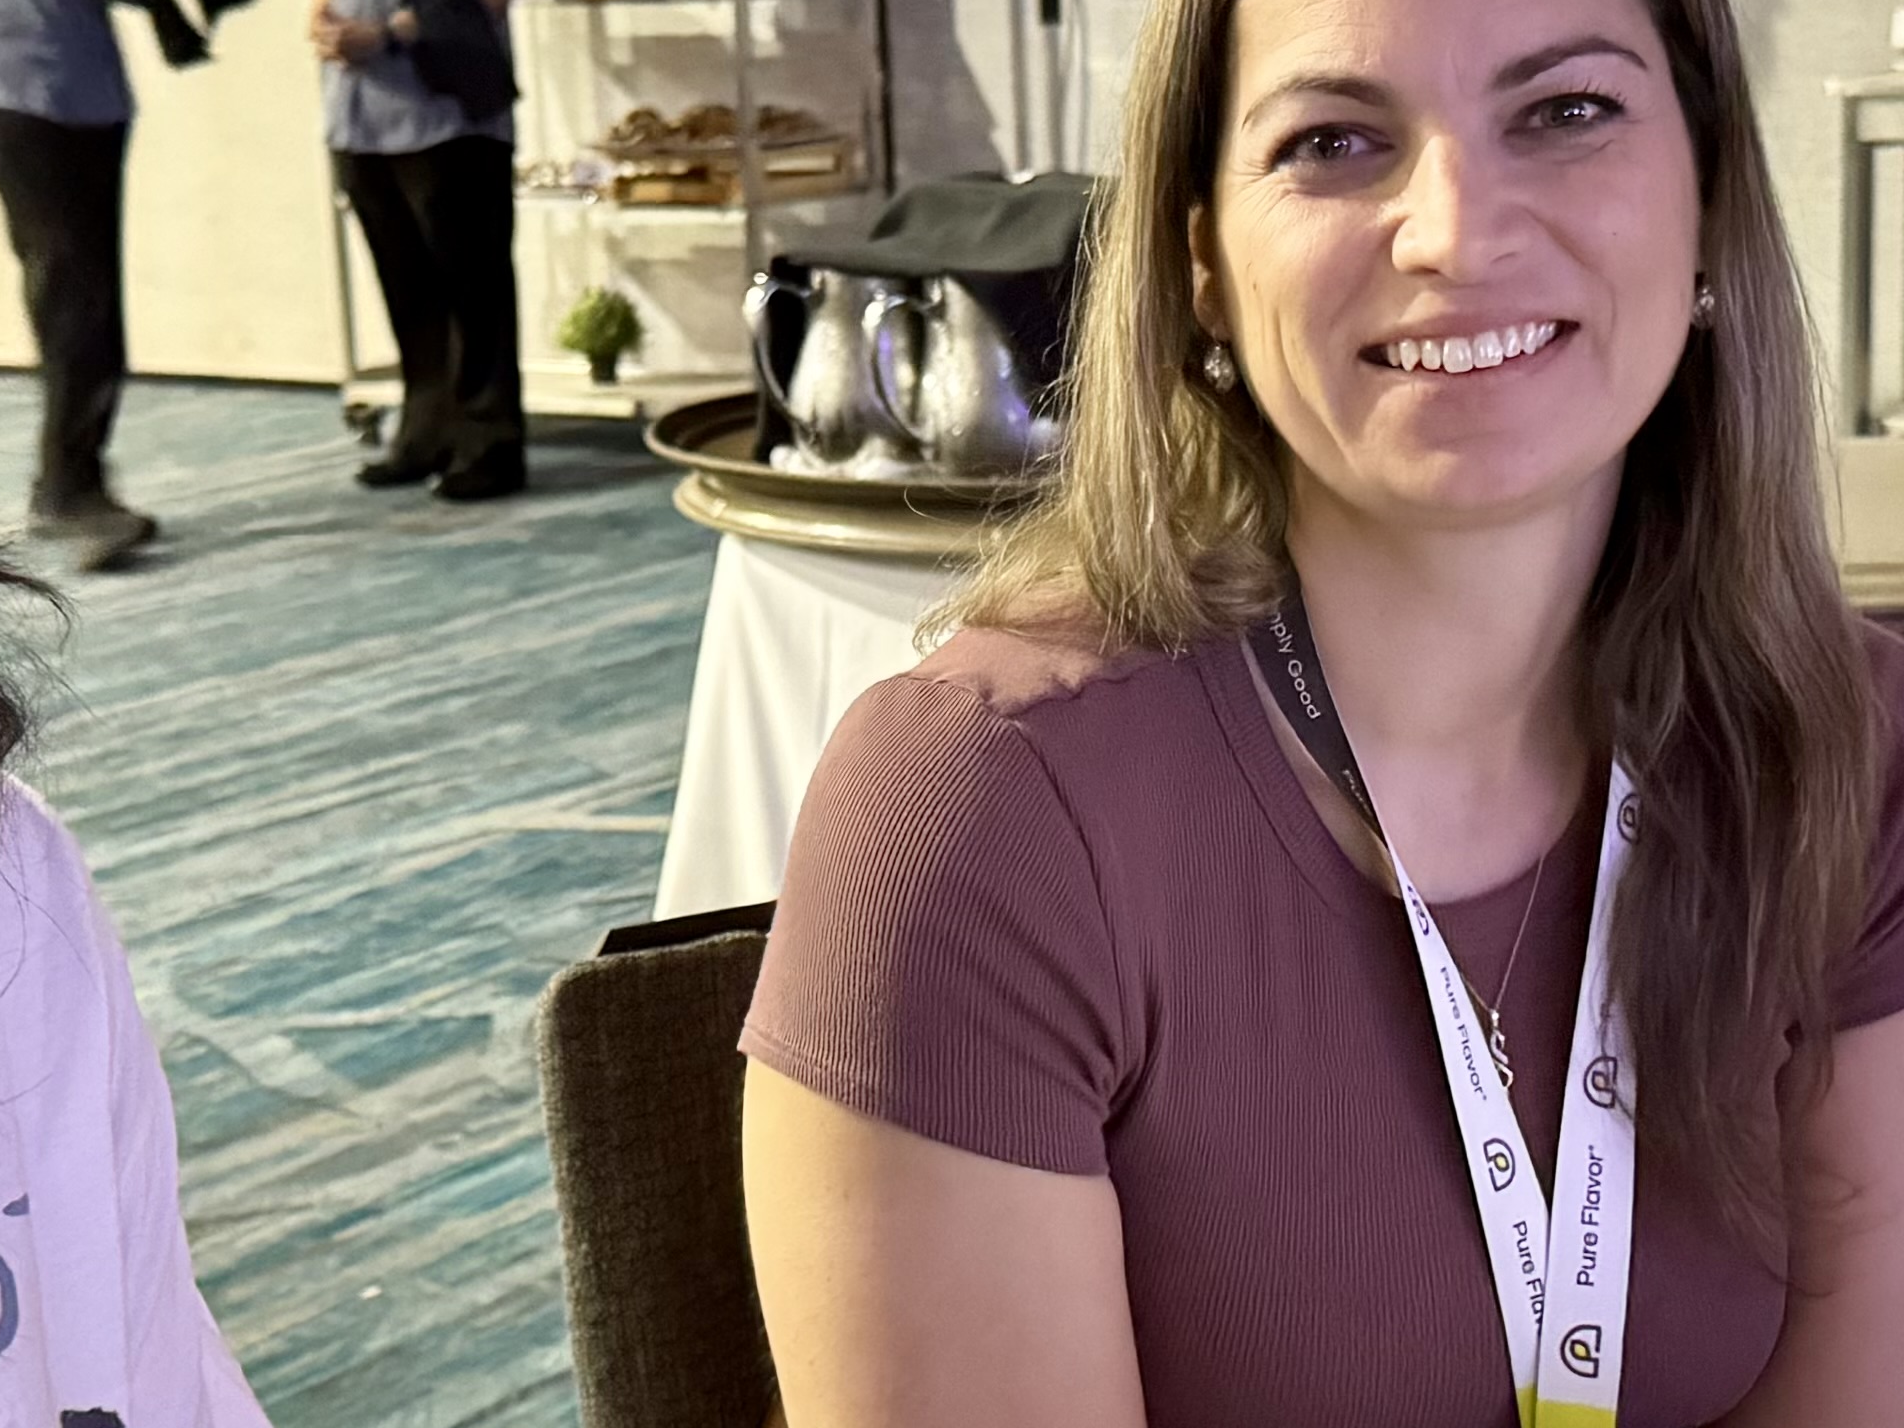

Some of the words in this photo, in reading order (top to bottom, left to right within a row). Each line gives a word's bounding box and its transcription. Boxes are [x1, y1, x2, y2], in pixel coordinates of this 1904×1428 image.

[1287, 659, 1322, 720] Good
[1440, 966, 1461, 1020] Pure
[1512, 1219, 1536, 1275] Pure
[1576, 1228, 1600, 1288] Pure
